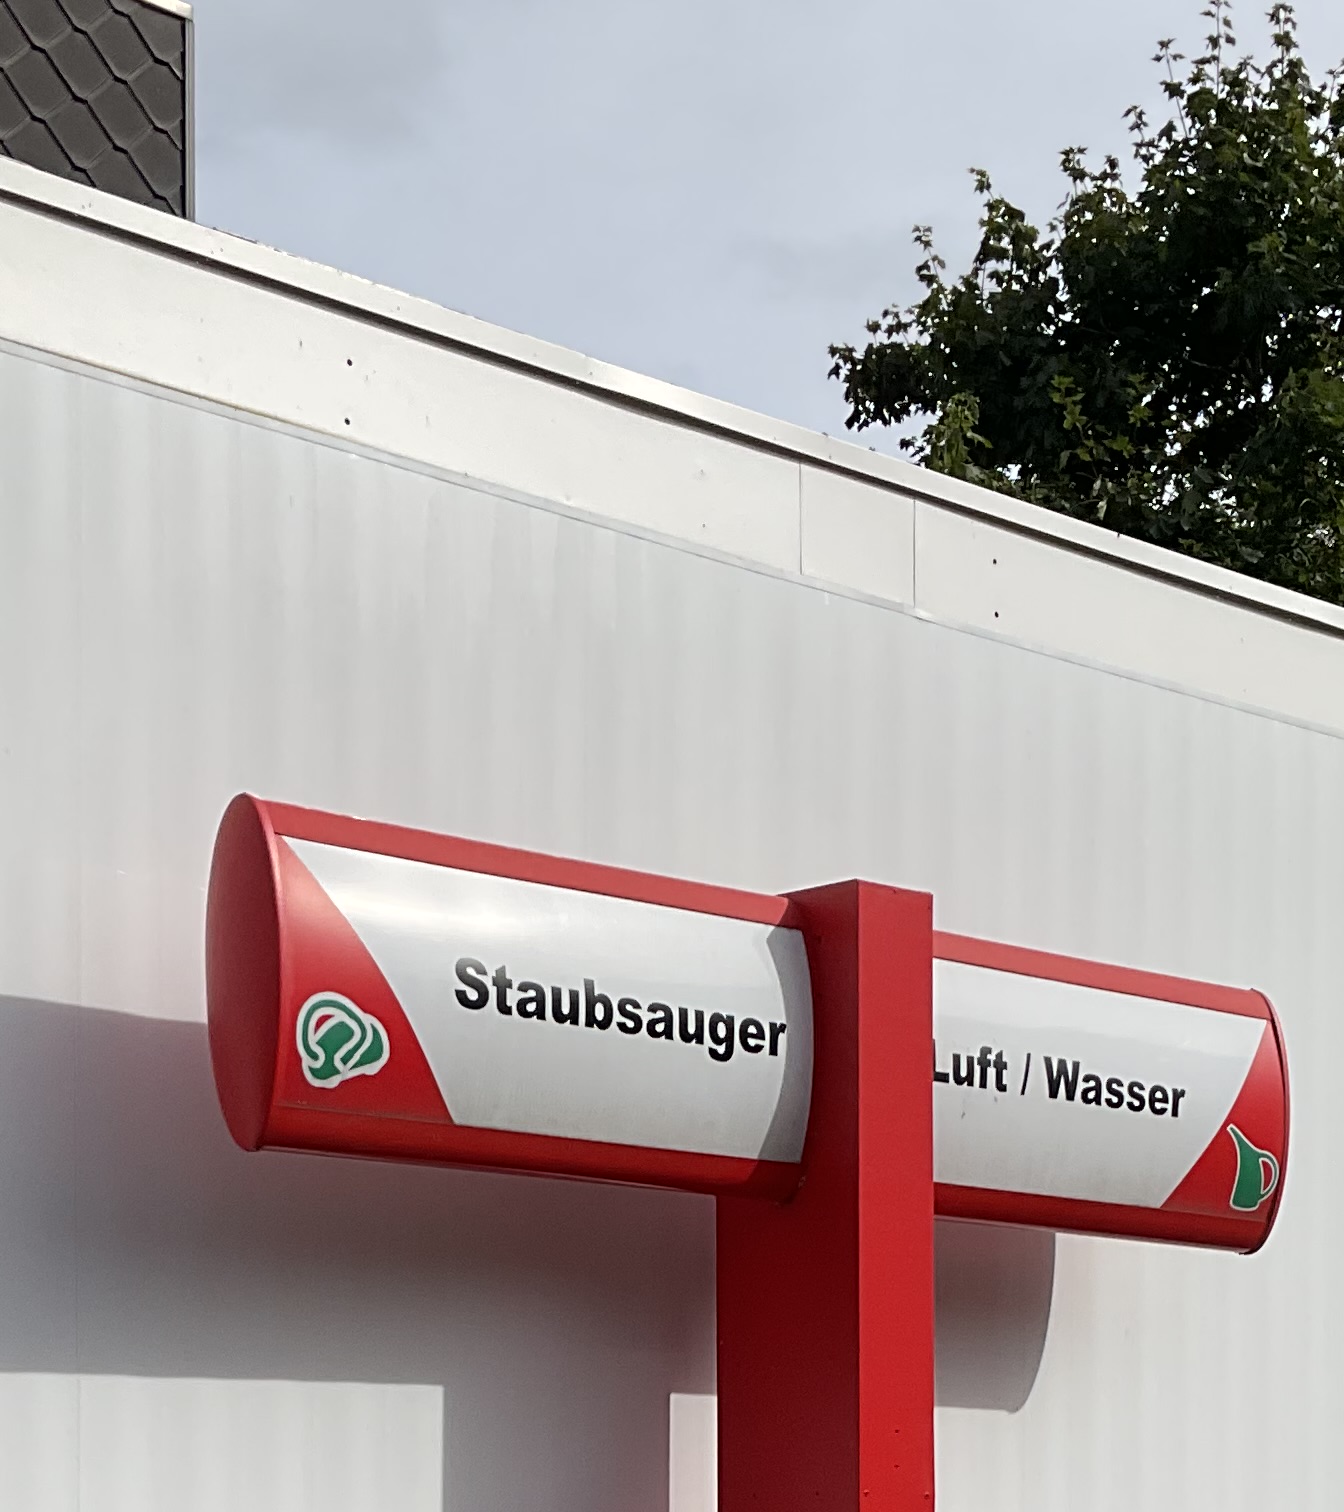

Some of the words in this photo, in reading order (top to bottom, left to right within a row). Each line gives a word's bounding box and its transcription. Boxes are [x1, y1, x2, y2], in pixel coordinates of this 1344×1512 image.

[454, 957, 787, 1062] Staubsauger
[933, 1039, 1008, 1093] Luft
[1020, 1053, 1031, 1096] /
[1044, 1056, 1186, 1117] Wasser
